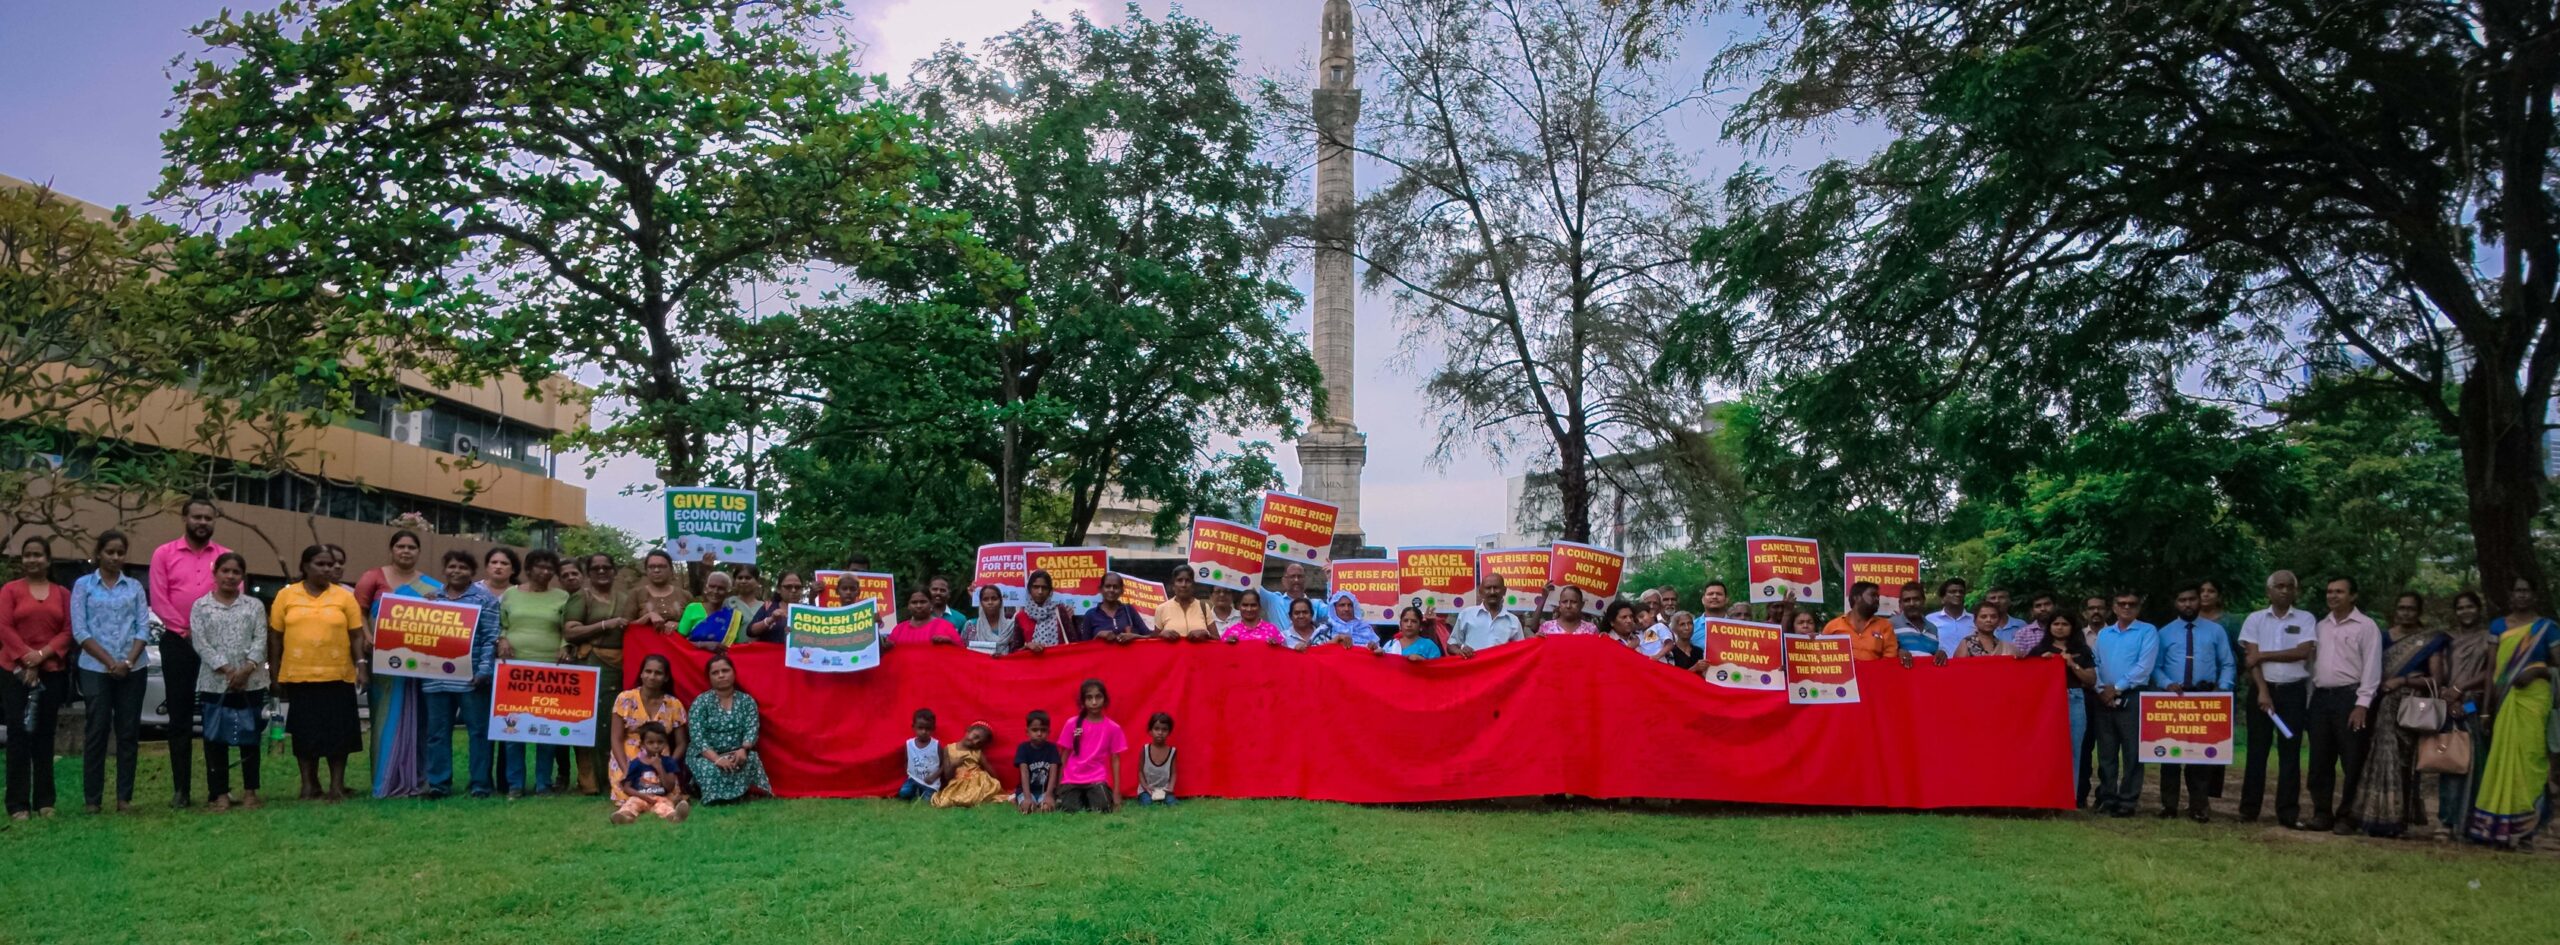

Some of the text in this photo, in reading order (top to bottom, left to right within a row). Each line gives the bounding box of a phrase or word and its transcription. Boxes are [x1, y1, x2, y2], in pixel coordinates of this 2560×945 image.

[674, 494, 747, 510] GIVE US
[674, 509, 746, 522] ECONOMIC
[1269, 502, 1333, 522] TAX THE RICH
[678, 521, 742, 534] EQUALITY
[1264, 514, 1332, 535] NOT THE POOR
[1199, 529, 1262, 550] TAX THE RICH
[1194, 541, 1262, 562] NOT THE POOR
[1761, 544, 1810, 553] CANCEL THE
[1036, 556, 1097, 568] CANCEL
[1408, 554, 1466, 566] CANCEL
[1505, 554, 1528, 562] RISE
[1530, 554, 1549, 562] FOR
[1557, 547, 1621, 567] A COUNTRY IS
[1754, 555, 1815, 565] DEBT, NOT OUR
[983, 562, 1023, 570] FOR PEO
[1492, 566, 1545, 575] MALAYAGA
[1576, 562, 1601, 576] NOT A
[1772, 566, 1803, 575] FUTURE
[1852, 564, 1914, 574] WE RISE FOR
[1030, 568, 1105, 579] EGITIMATE
[1338, 571, 1354, 579] WE
[1401, 567, 1473, 576] ILLEGITIMATE
[824, 577, 839, 585] WE
[868, 580, 888, 588] FOR
[1052, 579, 1081, 588] DEBT
[1423, 577, 1450, 586] DEBT
[1504, 578, 1548, 587] MMUNITY
[1564, 573, 1608, 590] COMPANY
[1855, 576, 1881, 584] FOOD
[1138, 583, 1153, 592] THE
[1340, 583, 1366, 591] FOOD
[1139, 592, 1165, 601] SHARE
[391, 604, 464, 626] CANCEL
[794, 608, 872, 624] ABOLISH TAX
[380, 618, 471, 639] ILLEGITIMATE
[794, 619, 872, 634] CONCESSION
[1711, 625, 1778, 639] A COUNTRY IS
[404, 633, 439, 647] DEBT
[1730, 640, 1759, 650] NOT A
[1795, 641, 1838, 650] SHARE THE
[1720, 652, 1770, 664] COMPANY
[1788, 653, 1850, 663] WEALTH, SHARE
[1811, 666, 1842, 674] POWER
[510, 668, 580, 685] GRANTS
[507, 682, 581, 696] NOT LOANS
[532, 696, 559, 706] FOR
[2155, 701, 2221, 709] CANCEL THE
[496, 704, 592, 717] CLIMATE FINANCE!
[2147, 713, 2227, 722] DEBT, NOT OUR
[2166, 726, 2207, 734] FUTURE
